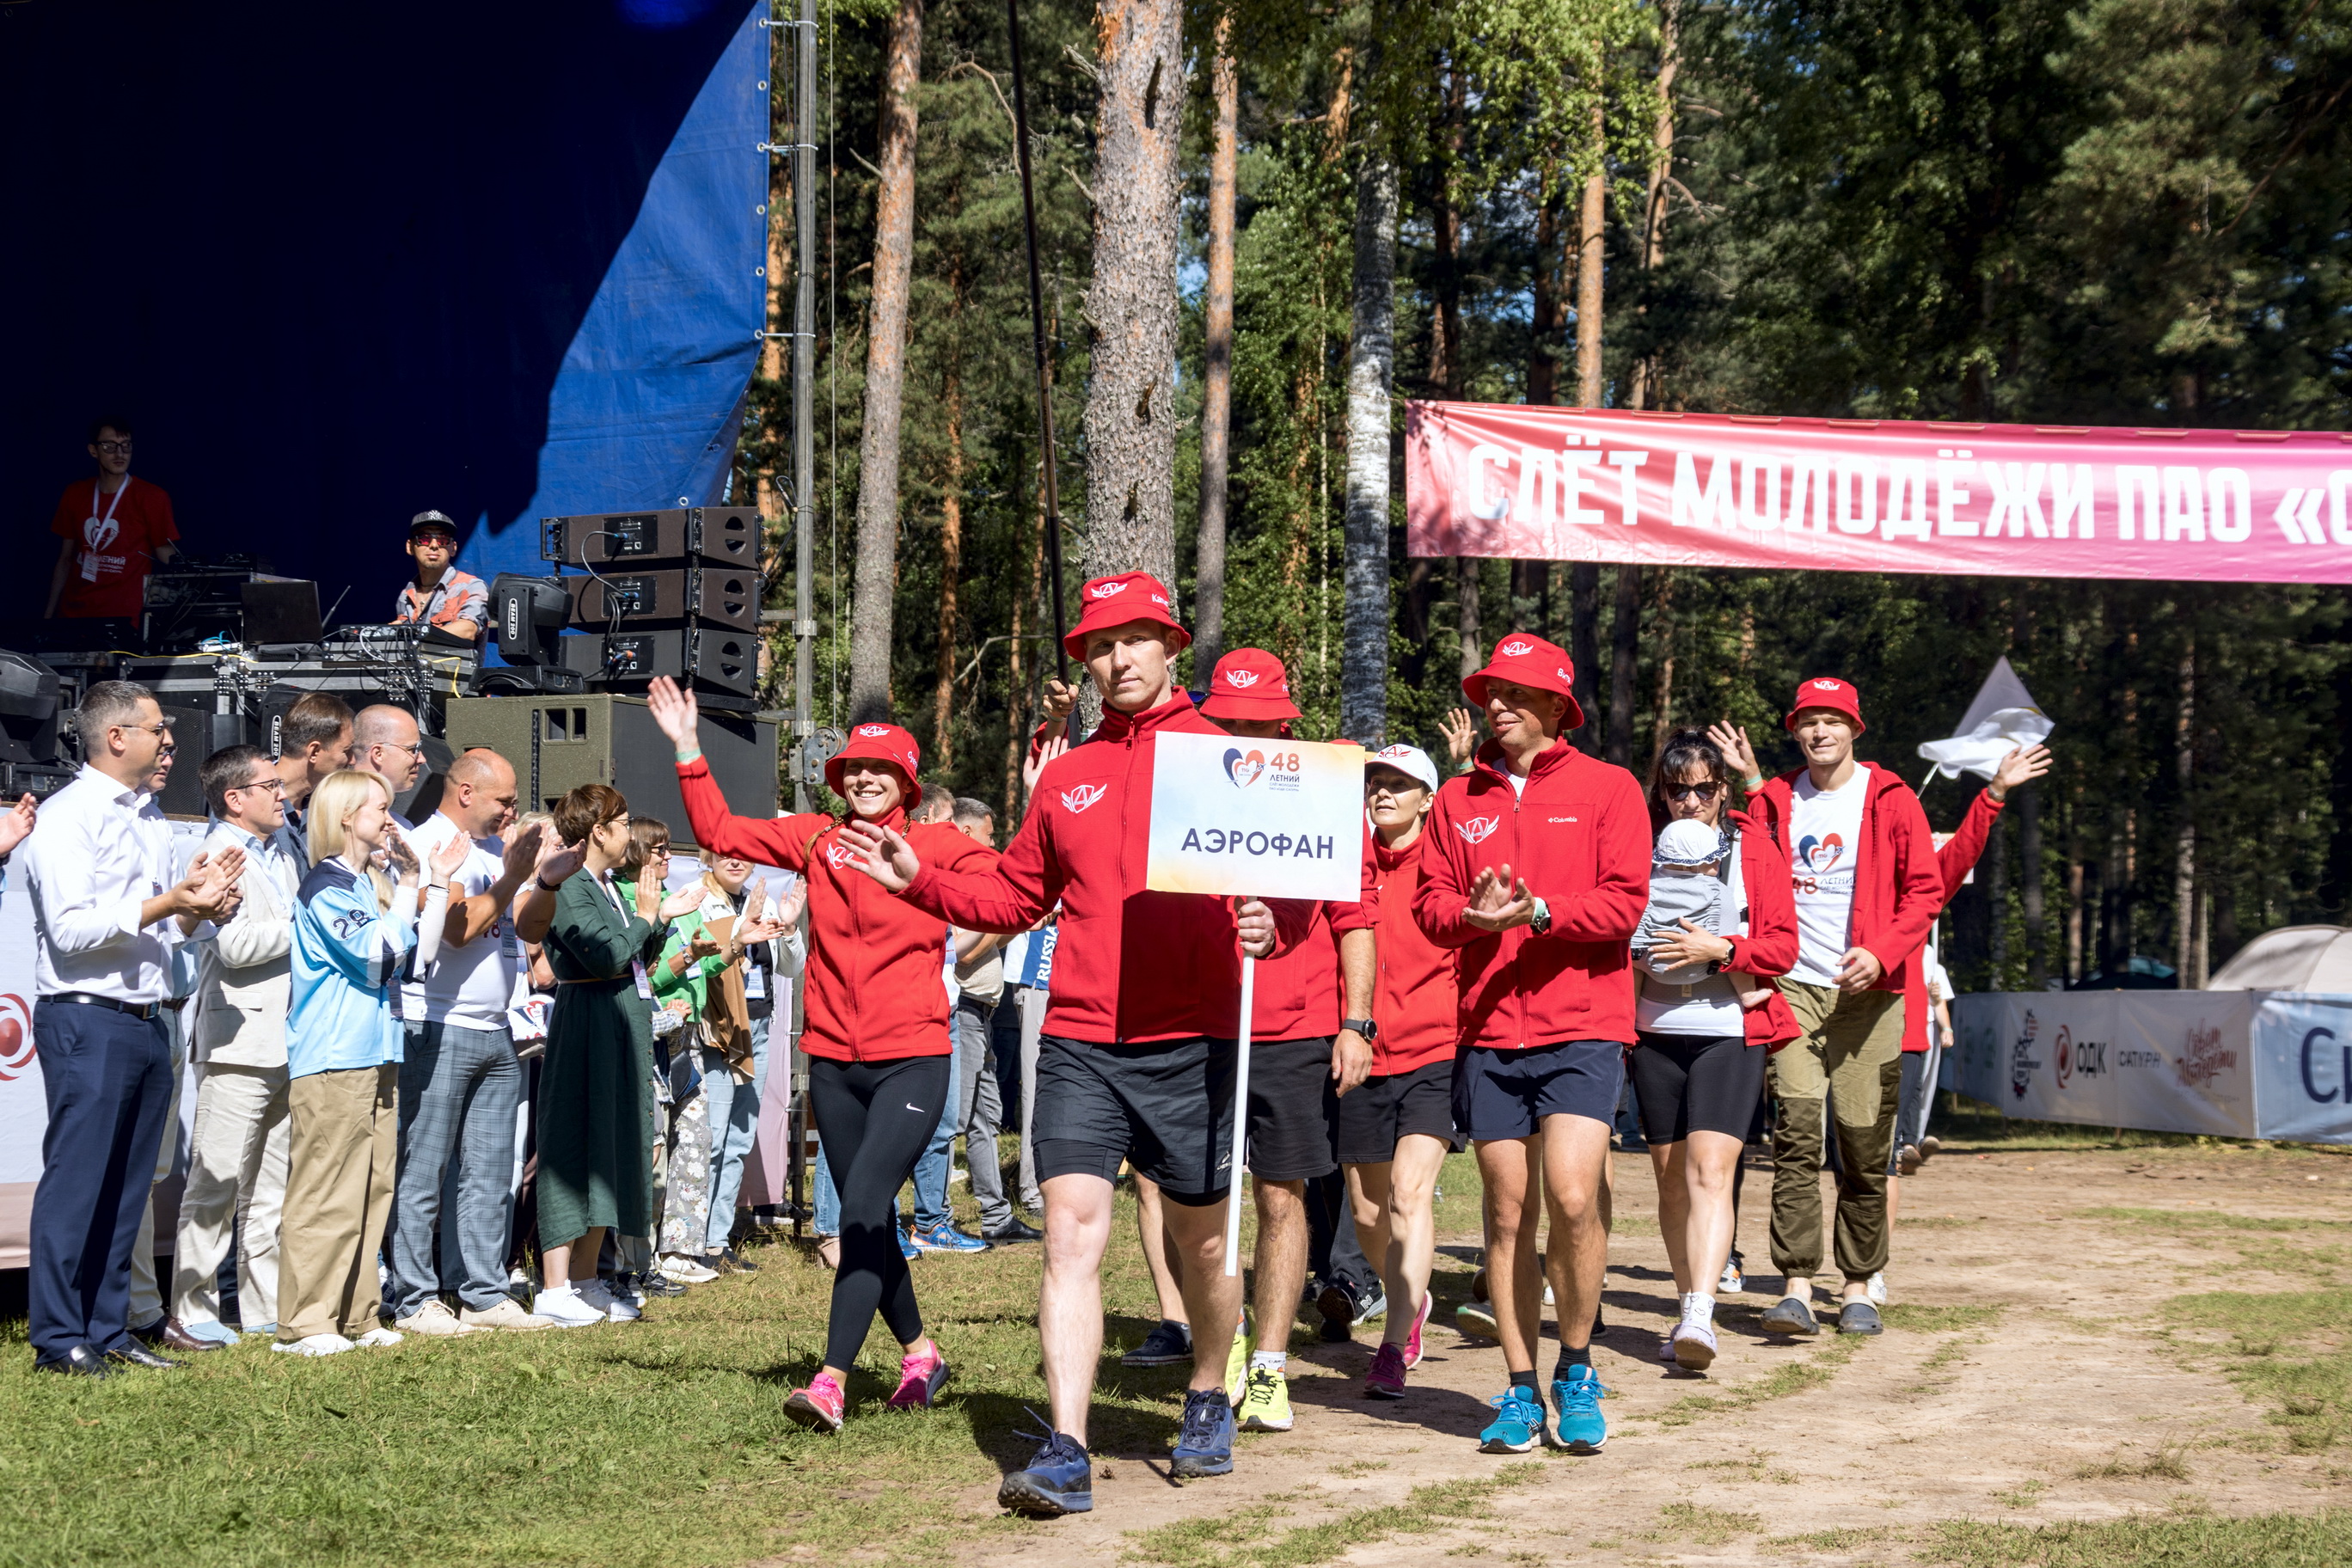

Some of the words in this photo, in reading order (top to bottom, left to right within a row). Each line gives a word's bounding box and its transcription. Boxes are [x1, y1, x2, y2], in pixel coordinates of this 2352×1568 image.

[1467, 434, 1649, 525] СЛЁТ
[1671, 448, 2095, 542] МОЛОДЁЖИ
[2116, 464, 2252, 542] ПАО
[1270, 773, 1301, 783] ЛЕТНИЙ
[1271, 752, 1301, 773] 48
[1180, 828, 1333, 860] АЭРОФАН
[1036, 926, 1059, 981] RUSSIA
[2077, 1042, 2107, 1078] ОДК
[2118, 1050, 2161, 1069] САТУРН
[2301, 1026, 2352, 1105] С
